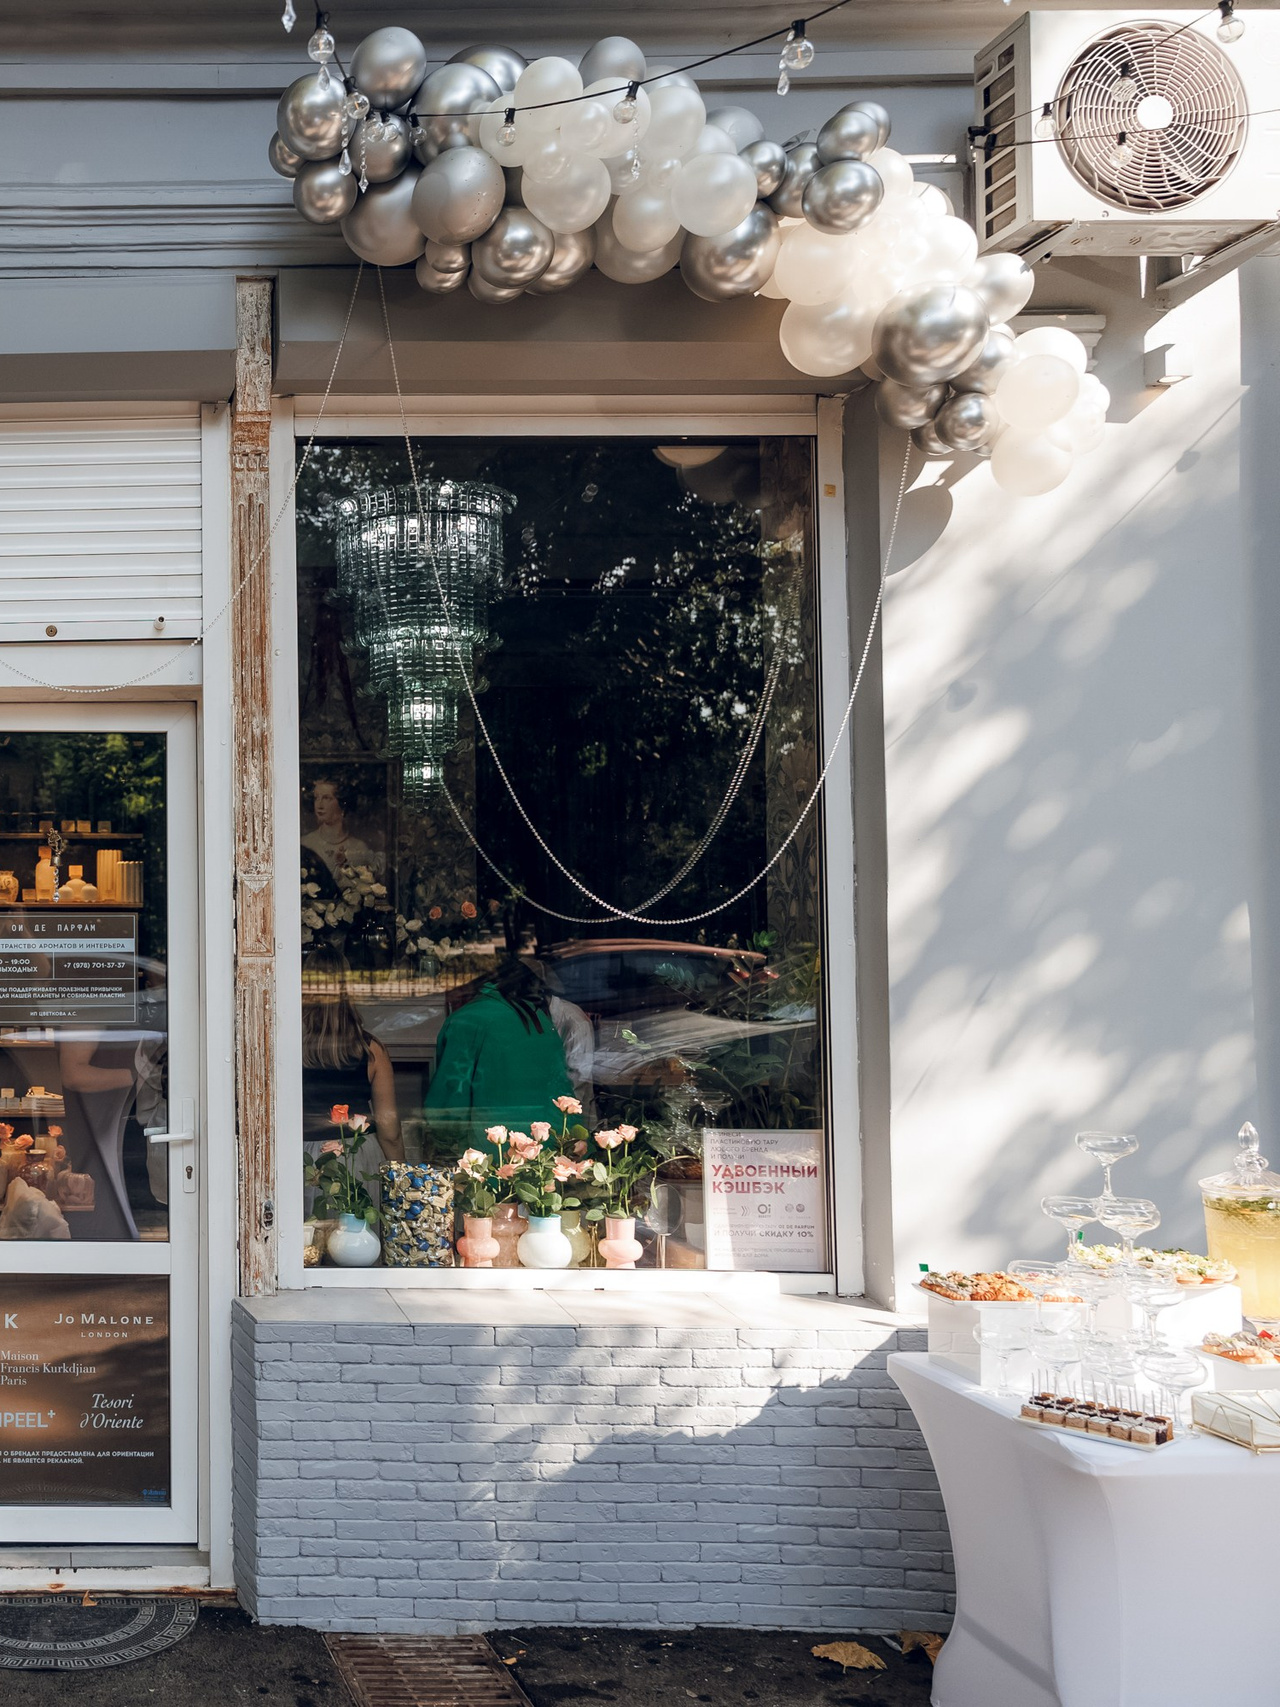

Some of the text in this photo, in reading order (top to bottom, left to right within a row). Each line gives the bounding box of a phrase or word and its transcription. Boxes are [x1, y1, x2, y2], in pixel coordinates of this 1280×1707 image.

[11, 924, 96, 932] ОИ ДЕ ПАРФАМ
[73, 962, 91, 970] (978)
[712, 1181, 786, 1194] КЭШБЭК
[759, 1230, 794, 1238] СКИДКУ
[797, 1230, 814, 1238] 10%
[0, 1350, 39, 1361] Maison
[0, 1362, 97, 1377] Francis Kurkdjian
[0, 1375, 27, 1386] Paris
[91, 1393, 135, 1409] Tesori
